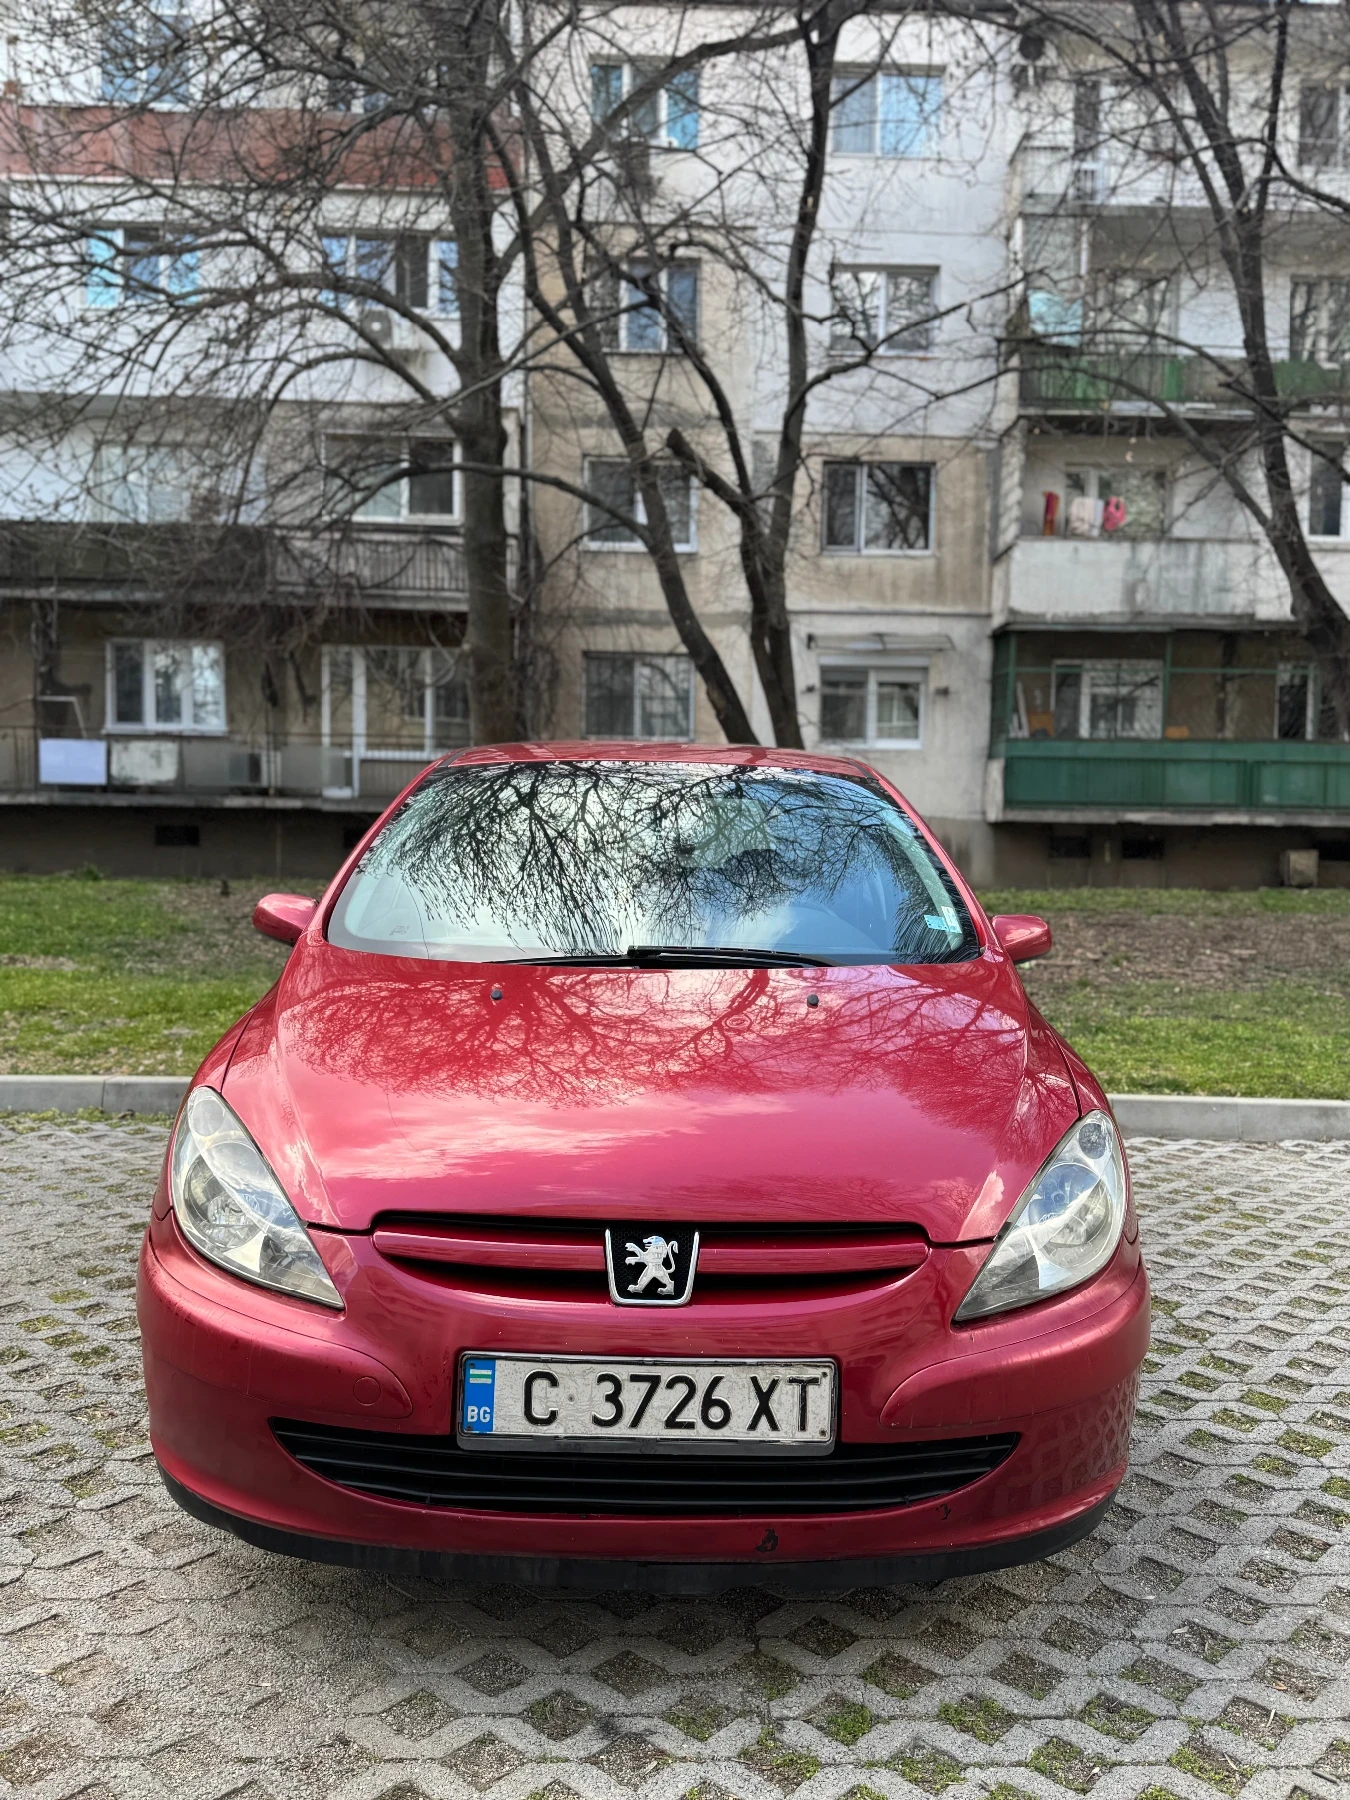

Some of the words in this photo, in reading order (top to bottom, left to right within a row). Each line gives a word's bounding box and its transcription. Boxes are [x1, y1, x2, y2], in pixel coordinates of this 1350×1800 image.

[467, 1405, 491, 1423] BG
[523, 1370, 559, 1426] C
[591, 1372, 733, 1430] 3726
[746, 1375, 821, 1432] XT
